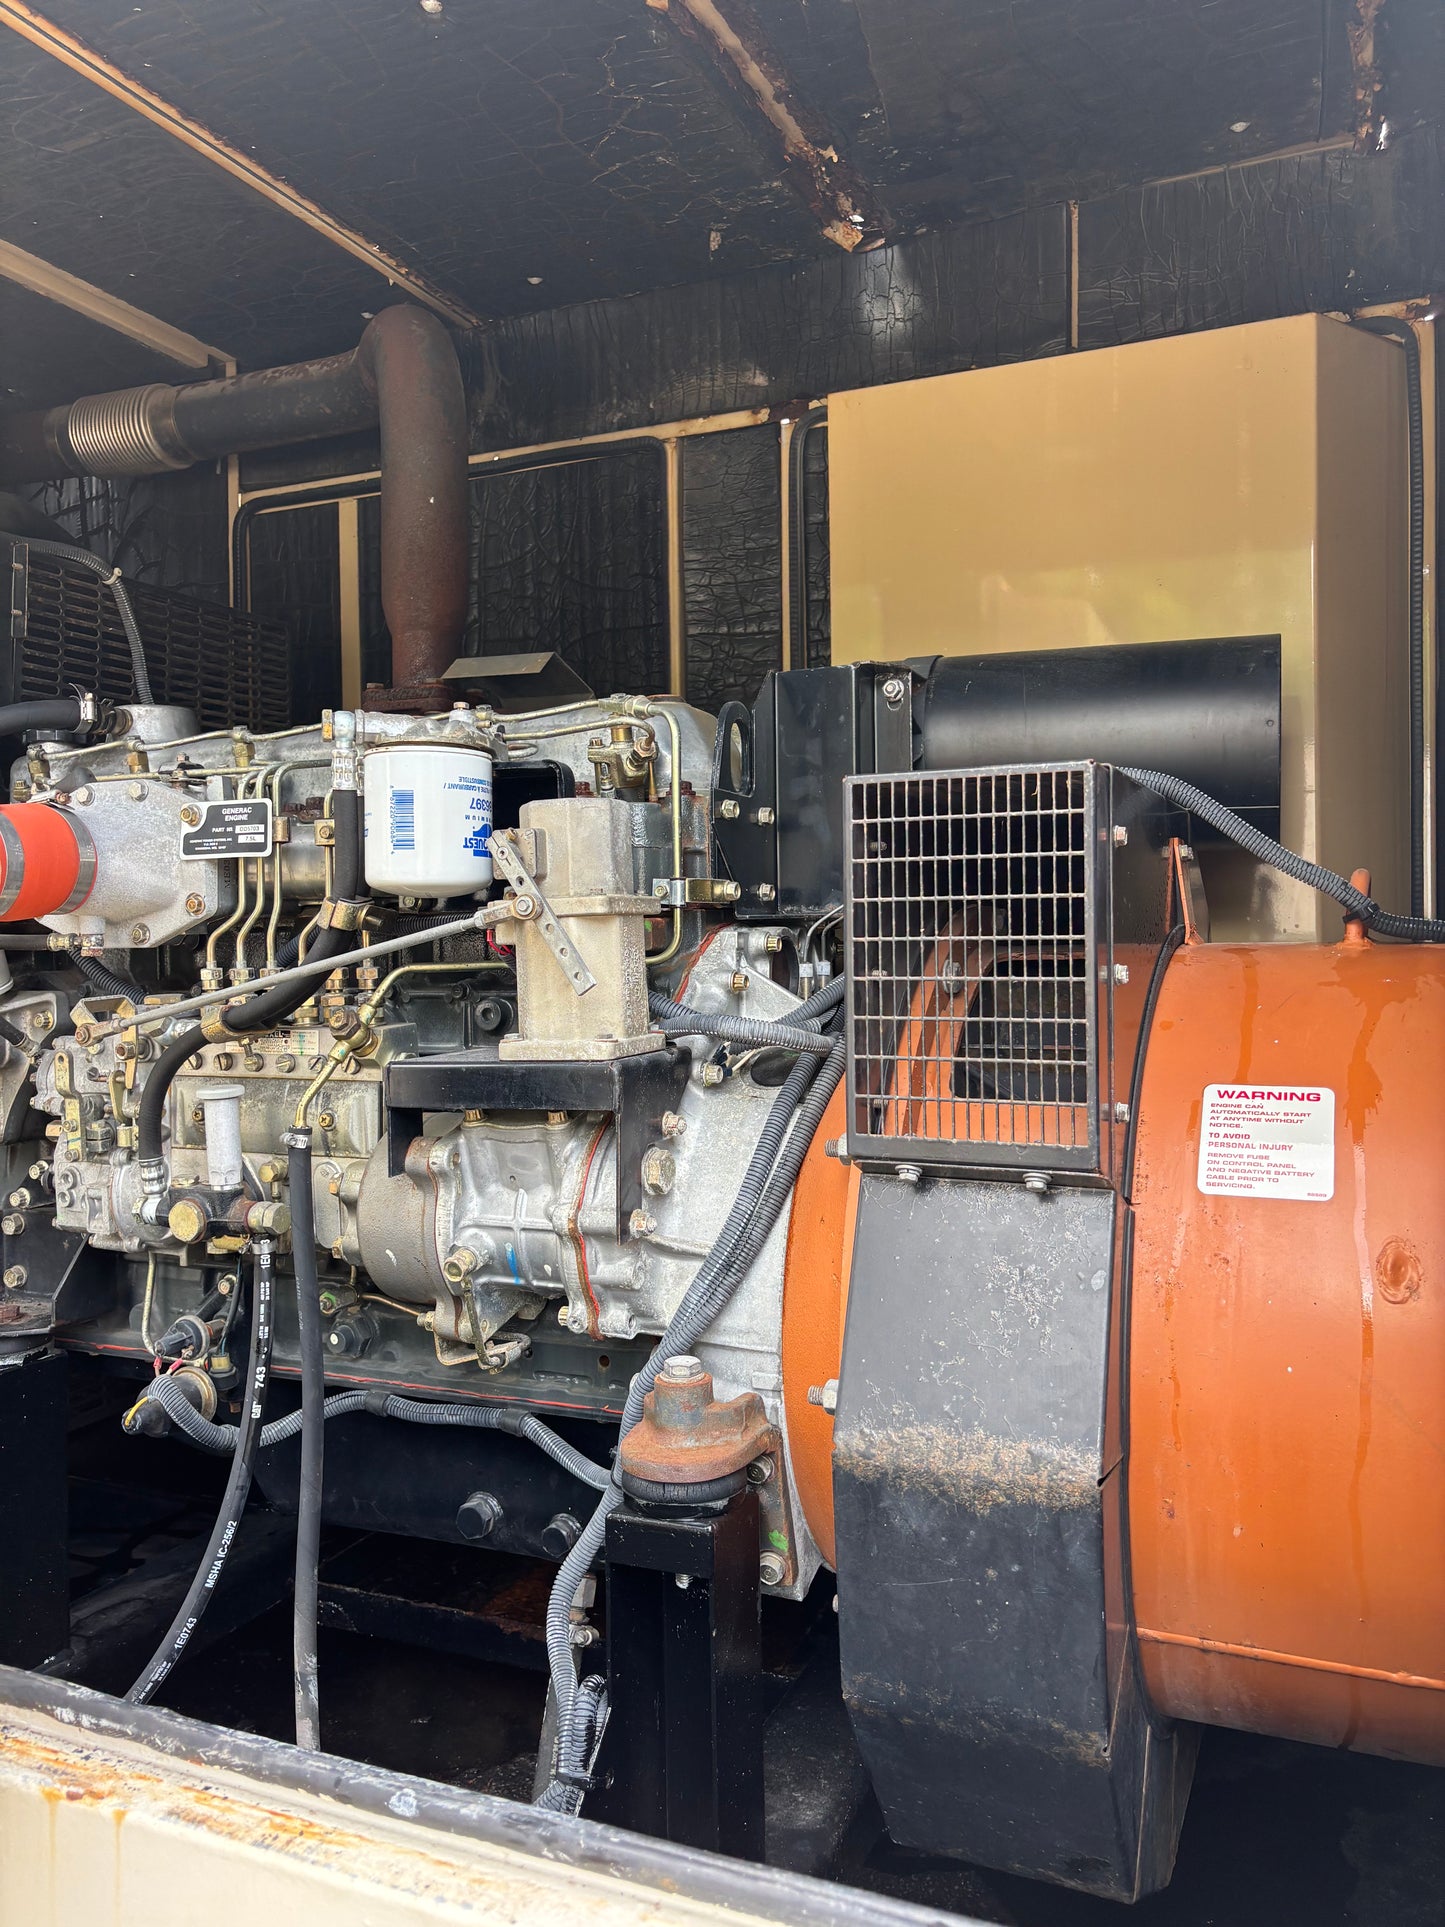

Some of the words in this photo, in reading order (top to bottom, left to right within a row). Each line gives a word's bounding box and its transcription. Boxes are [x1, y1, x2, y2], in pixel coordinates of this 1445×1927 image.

[221, 806, 253, 815] GENERAC
[224, 813, 249, 822] ENGINE
[463, 837, 488, 850] QUEST
[1217, 1090, 1321, 1102] WARNING
[1210, 1109, 1281, 1117] AUTOMATICALLY
[1208, 1141, 1256, 1150] PERSONAL
[1259, 1143, 1294, 1151] INJURY
[1205, 1181, 1256, 1189] SERVICING.
[260, 1238, 270, 1270] 1E03
[254, 1366, 266, 1389] 743
[251, 1401, 262, 1419] CAT
[204, 1560, 224, 1588] MSHA
[216, 1520, 237, 1558] IC-256/2
[174, 1616, 198, 1650] 1E0743
